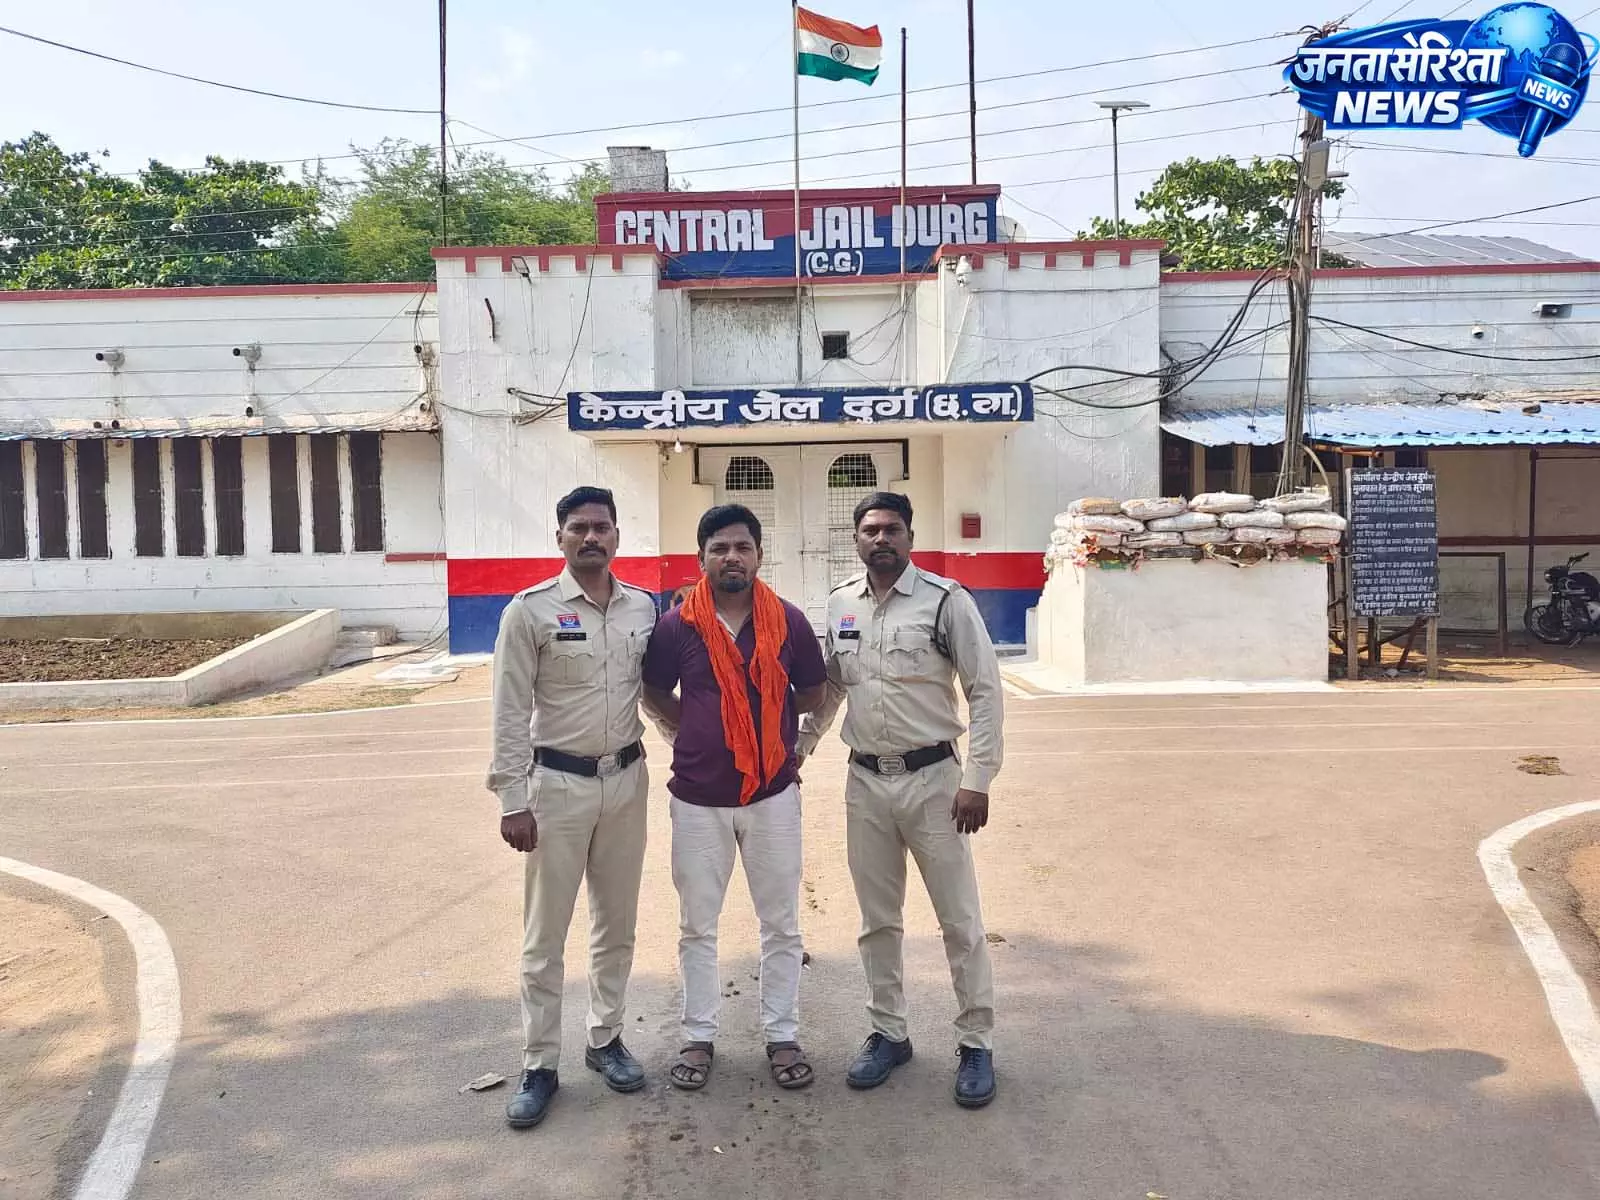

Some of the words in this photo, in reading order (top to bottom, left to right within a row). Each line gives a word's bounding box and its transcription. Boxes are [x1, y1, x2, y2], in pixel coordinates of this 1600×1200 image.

[615, 208, 774, 253] CENTRAL
[800, 205, 885, 251] JAIL
[891, 202, 988, 247] DURG
[805, 249, 864, 277] (C.G.)
[578, 390, 728, 430] केन्द्रीय
[738, 390, 823, 422] जेल
[843, 389, 919, 424] दुर्ग
